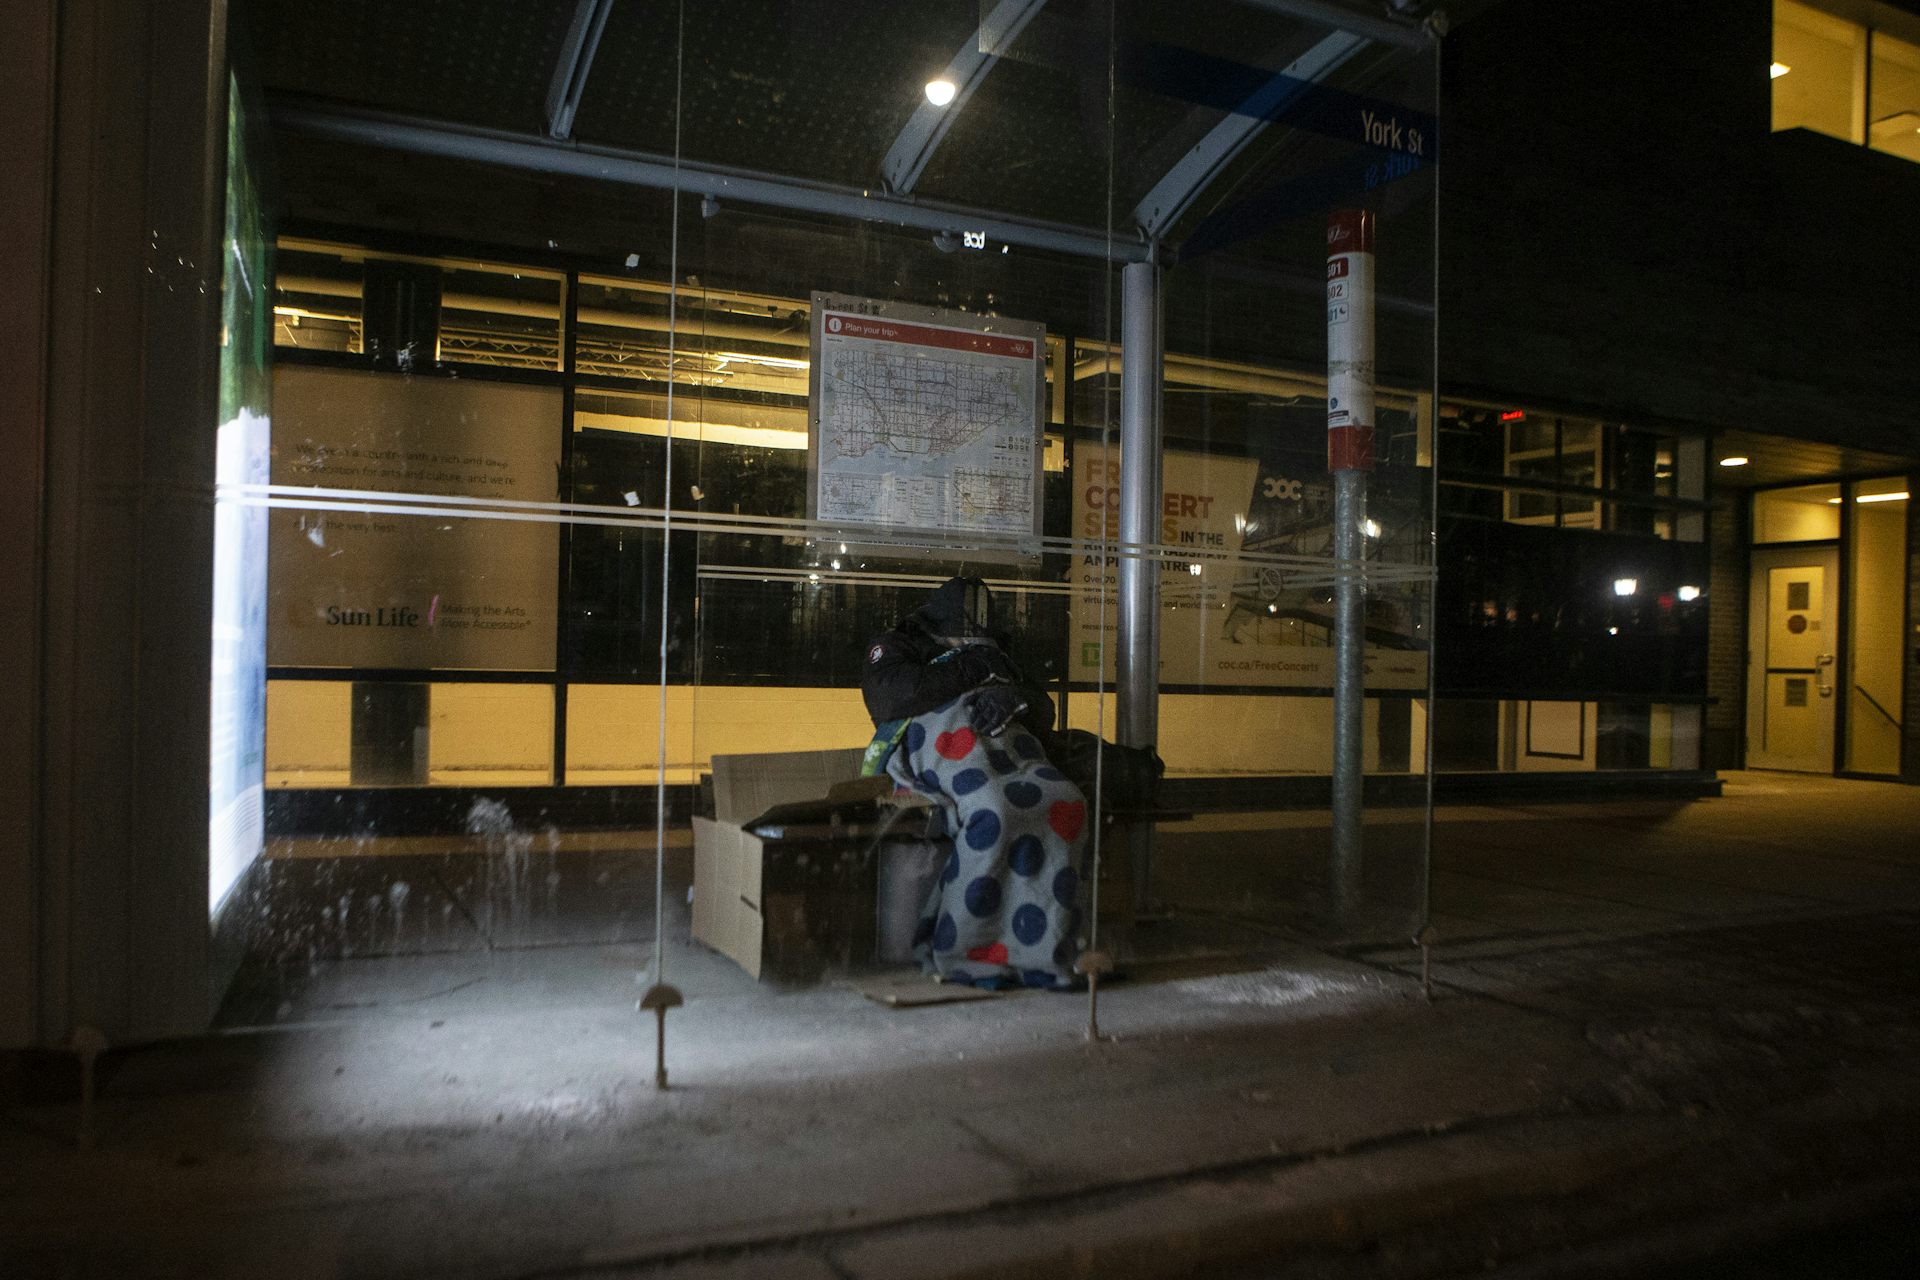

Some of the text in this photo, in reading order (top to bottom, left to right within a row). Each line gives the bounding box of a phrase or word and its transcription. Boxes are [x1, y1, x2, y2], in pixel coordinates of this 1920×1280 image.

[1360, 109, 1424, 157] York St
[845, 322, 897, 341] Plan your trip
[1084, 485, 1214, 519] COERT
[1180, 531, 1194, 543] IN
[1197, 532, 1224, 546] THE
[1105, 576, 1116, 584] 70
[326, 605, 419, 628] Sun Life
[441, 604, 526, 618] Making the Arts
[440, 618, 470, 629] More
[1218, 660, 1320, 672] coc.ca/FreeConcerts
